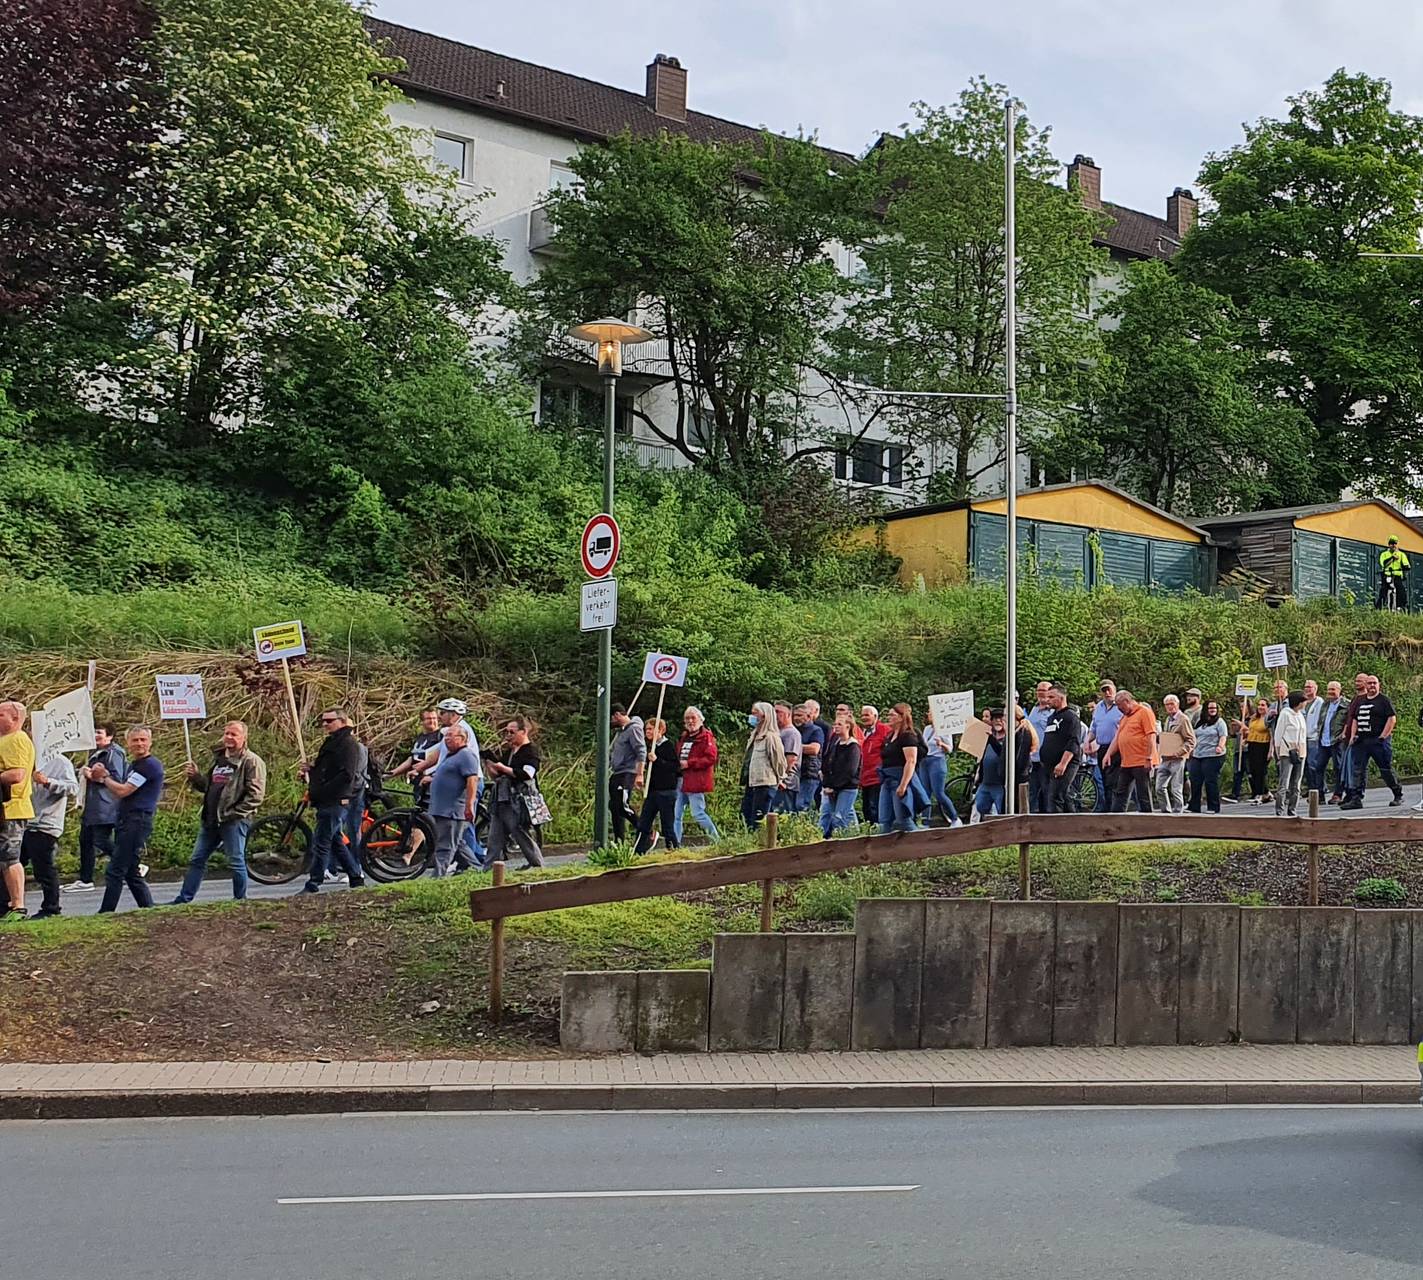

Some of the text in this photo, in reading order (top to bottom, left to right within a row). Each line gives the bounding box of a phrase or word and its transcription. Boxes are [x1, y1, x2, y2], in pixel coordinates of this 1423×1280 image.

[587, 588, 610, 598] Liefer-
[585, 600, 610, 611] verkehr
[593, 612, 603, 623] frei
